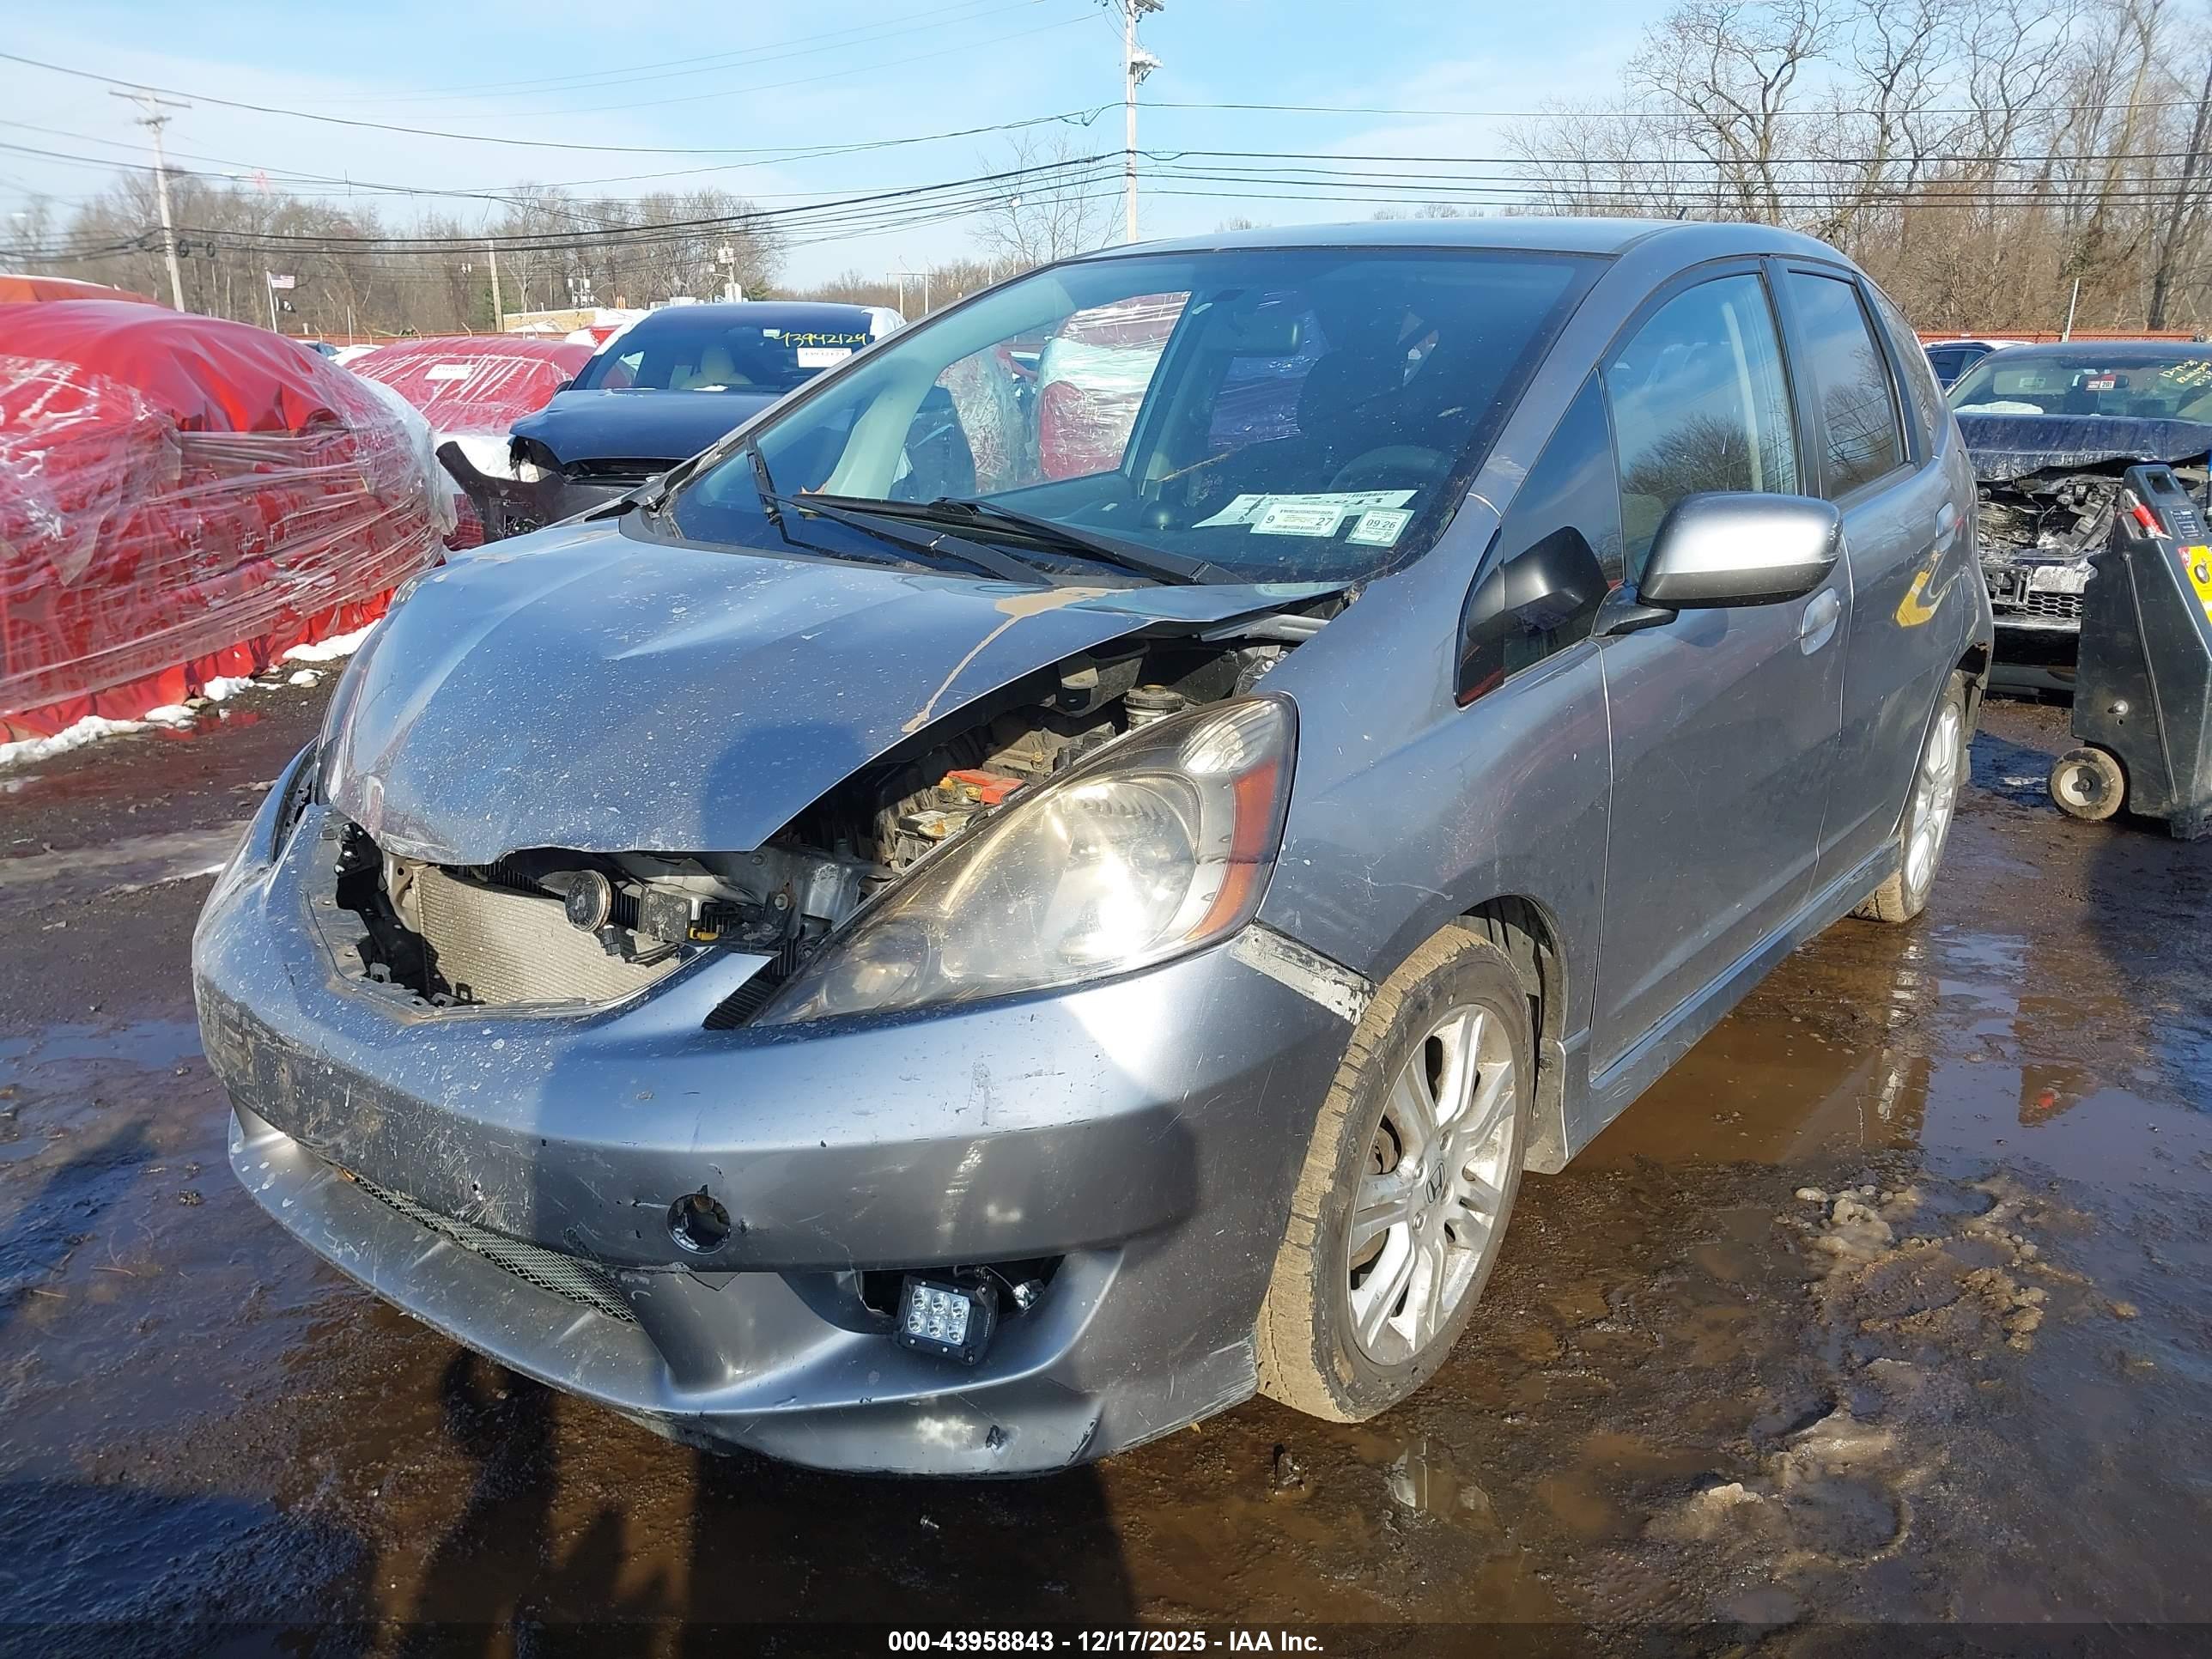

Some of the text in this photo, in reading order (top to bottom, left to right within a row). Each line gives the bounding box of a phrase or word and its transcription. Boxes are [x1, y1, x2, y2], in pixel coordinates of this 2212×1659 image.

[1266, 515, 1275, 524] 9
[1318, 517, 1334, 526] 27
[1365, 519, 1381, 527] 09
[1382, 520, 1397, 529] 26
